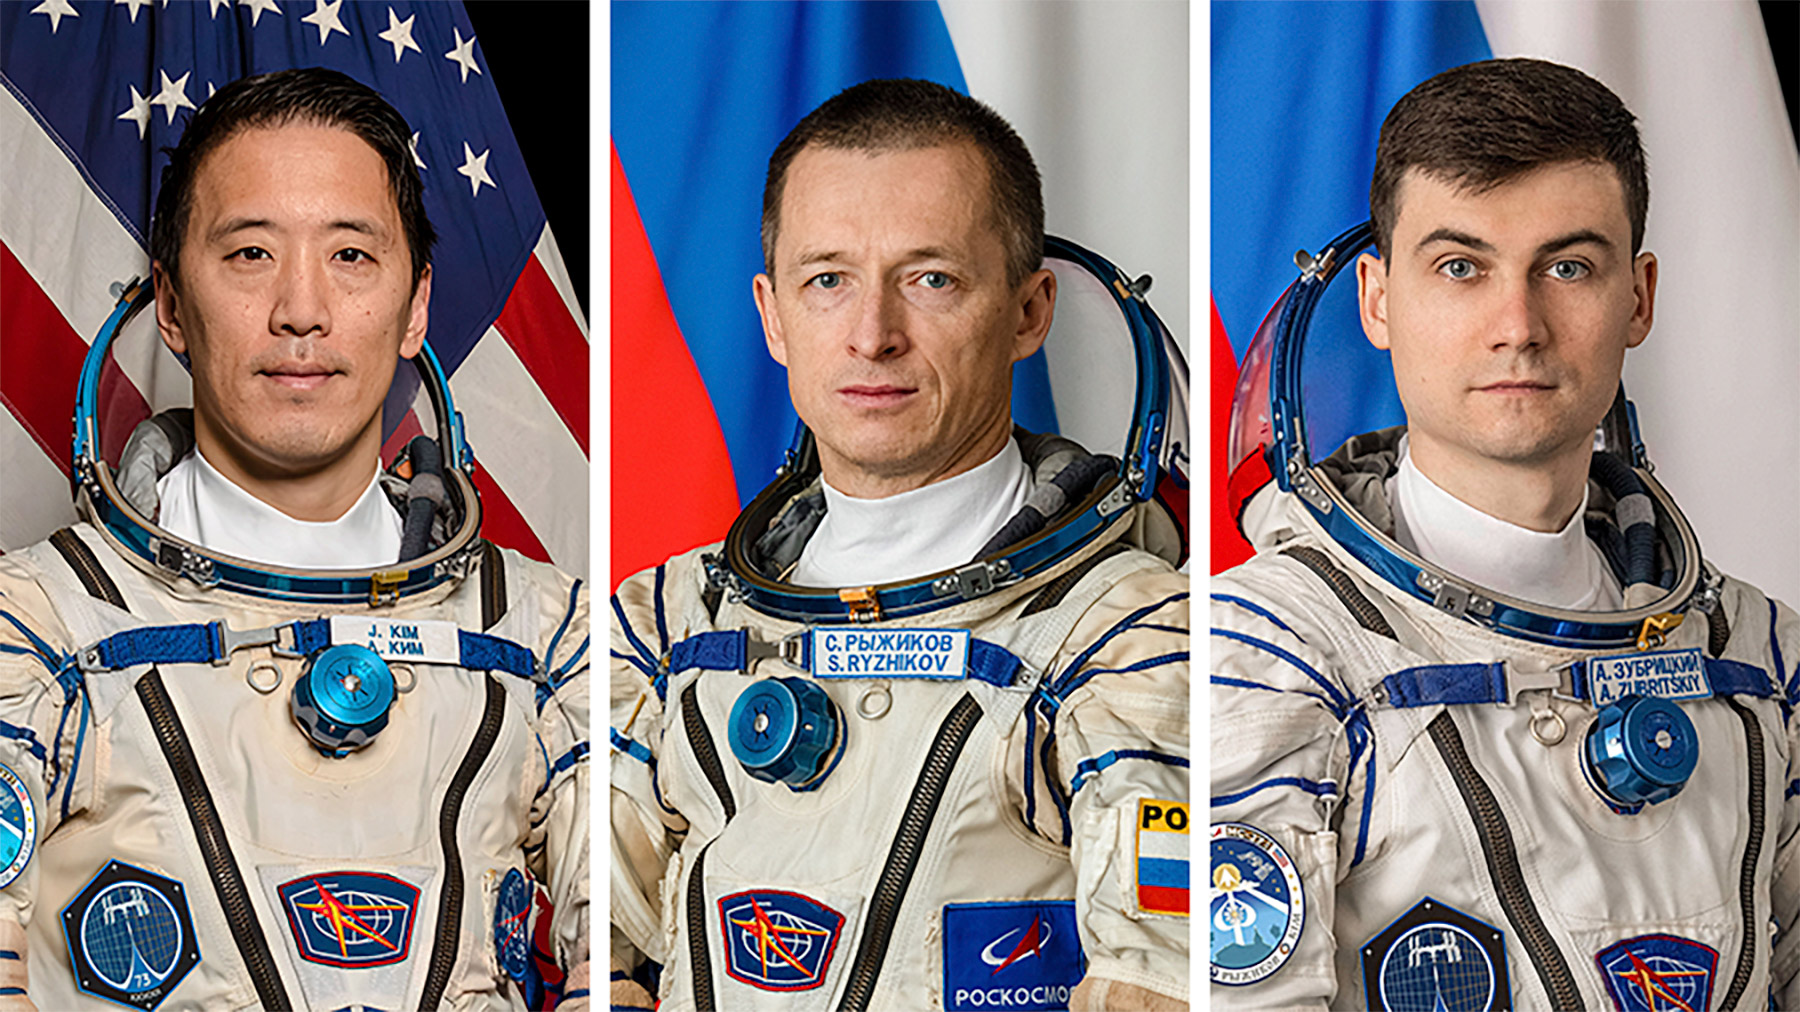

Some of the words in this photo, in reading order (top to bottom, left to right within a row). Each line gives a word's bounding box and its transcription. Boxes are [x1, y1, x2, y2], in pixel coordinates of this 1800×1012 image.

[368, 624, 382, 638] J.
[389, 625, 419, 640] KIM
[388, 641, 424, 656] КИМ
[1613, 651, 1700, 680] ЗУБРИЦКИЙ
[134, 972, 152, 988] 73
